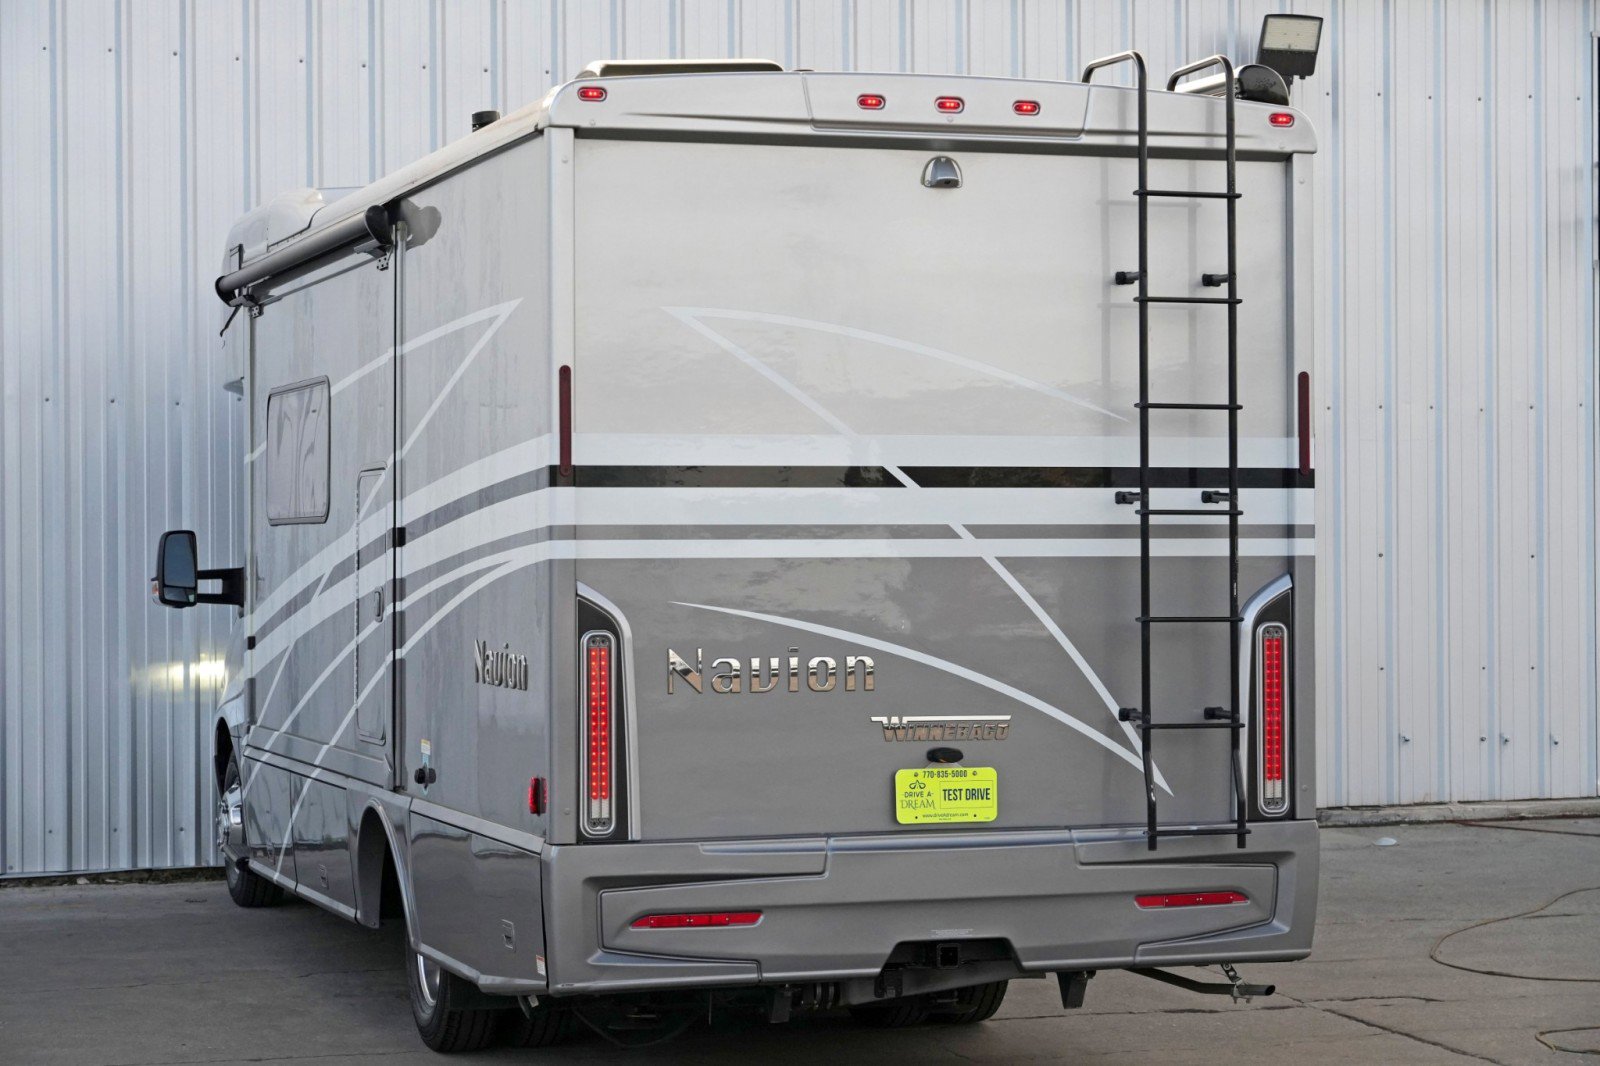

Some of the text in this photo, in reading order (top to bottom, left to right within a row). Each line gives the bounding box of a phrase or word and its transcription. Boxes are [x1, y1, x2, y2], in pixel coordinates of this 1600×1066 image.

[475, 639, 528, 691] Navion
[667, 646, 875, 695] Navion
[870, 715, 1012, 742] WINNEBAGO
[922, 770, 968, 779] 770-835-5000
[901, 799, 936, 810] DREAM
[942, 788, 991, 801] TEST DRIVE
